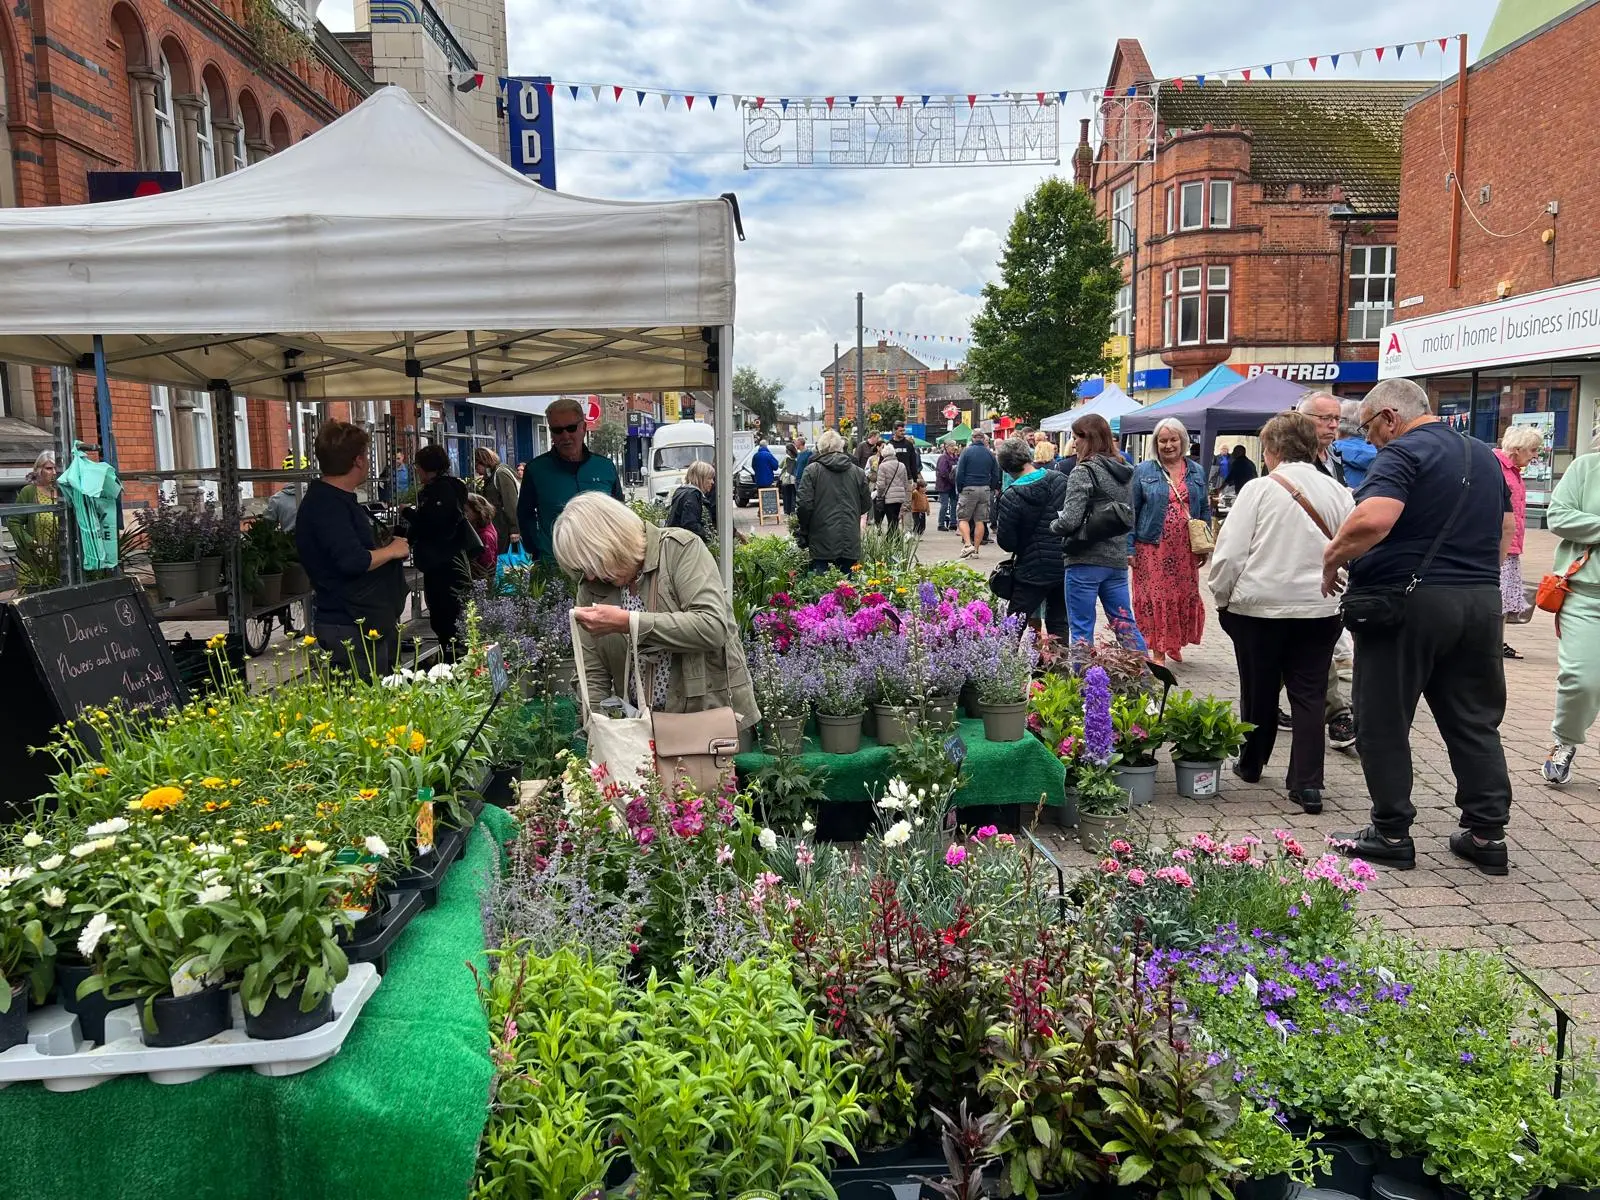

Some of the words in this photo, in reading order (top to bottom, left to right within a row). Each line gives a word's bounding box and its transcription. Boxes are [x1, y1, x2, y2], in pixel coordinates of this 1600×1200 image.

[519, 85, 541, 180] OD
[1422, 332, 1455, 354] motor
[1462, 325, 1496, 348] home
[1507, 313, 1563, 341] business
[1567, 307, 1600, 330] insu
[62, 613, 108, 644] Daniels
[57, 651, 94, 683] Flowers
[96, 644, 112, 666] and
[110, 641, 141, 662] Plants
